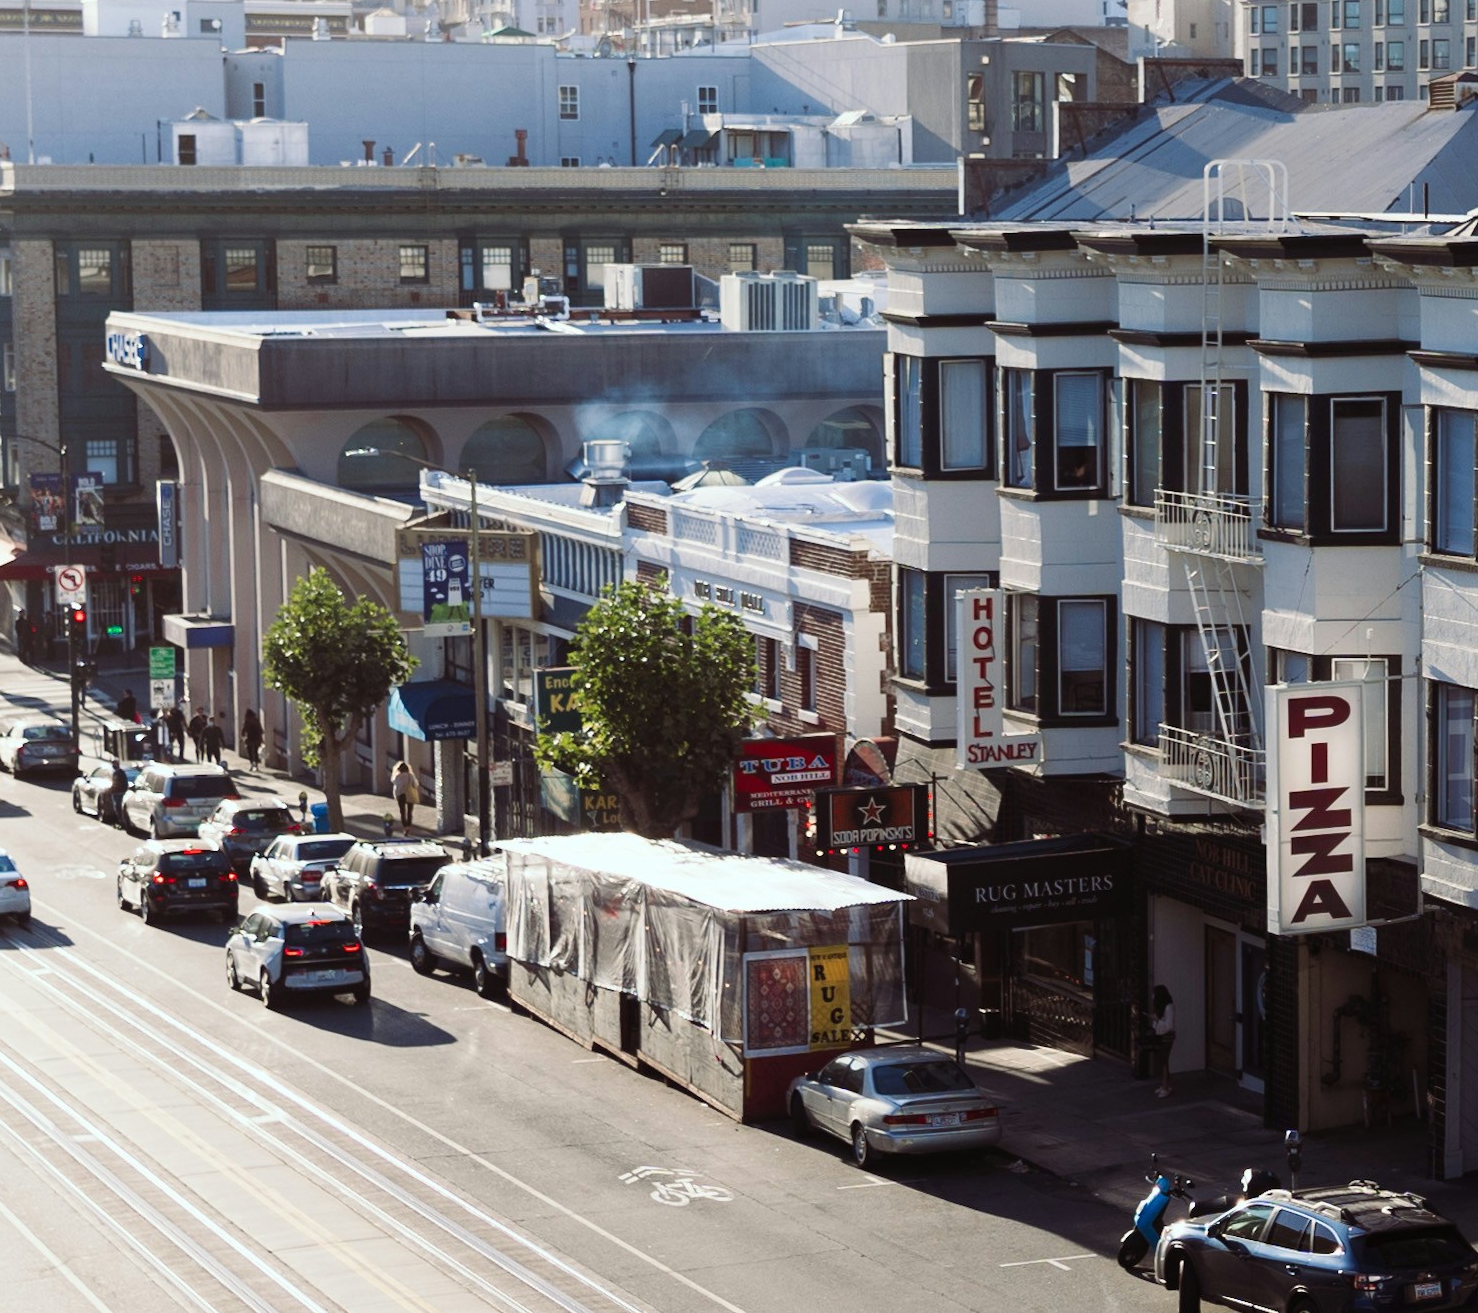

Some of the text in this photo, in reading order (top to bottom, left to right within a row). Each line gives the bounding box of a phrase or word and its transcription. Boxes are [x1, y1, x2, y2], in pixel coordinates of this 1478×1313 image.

[162, 498, 172, 546] CHASE
[425, 569, 447, 583] 49
[973, 597, 994, 738] HOTEL
[967, 741, 1038, 764] STANLEY
[739, 755, 830, 774] TUBA
[774, 772, 829, 783] NOB HILL
[750, 799, 783, 808] GRILL
[1287, 695, 1353, 924] PIZZA
[833, 829, 860, 845] SODA
[975, 874, 1114, 903] RUG MASTERS
[813, 964, 845, 1025] RUG
[811, 1029, 850, 1043] SALE
